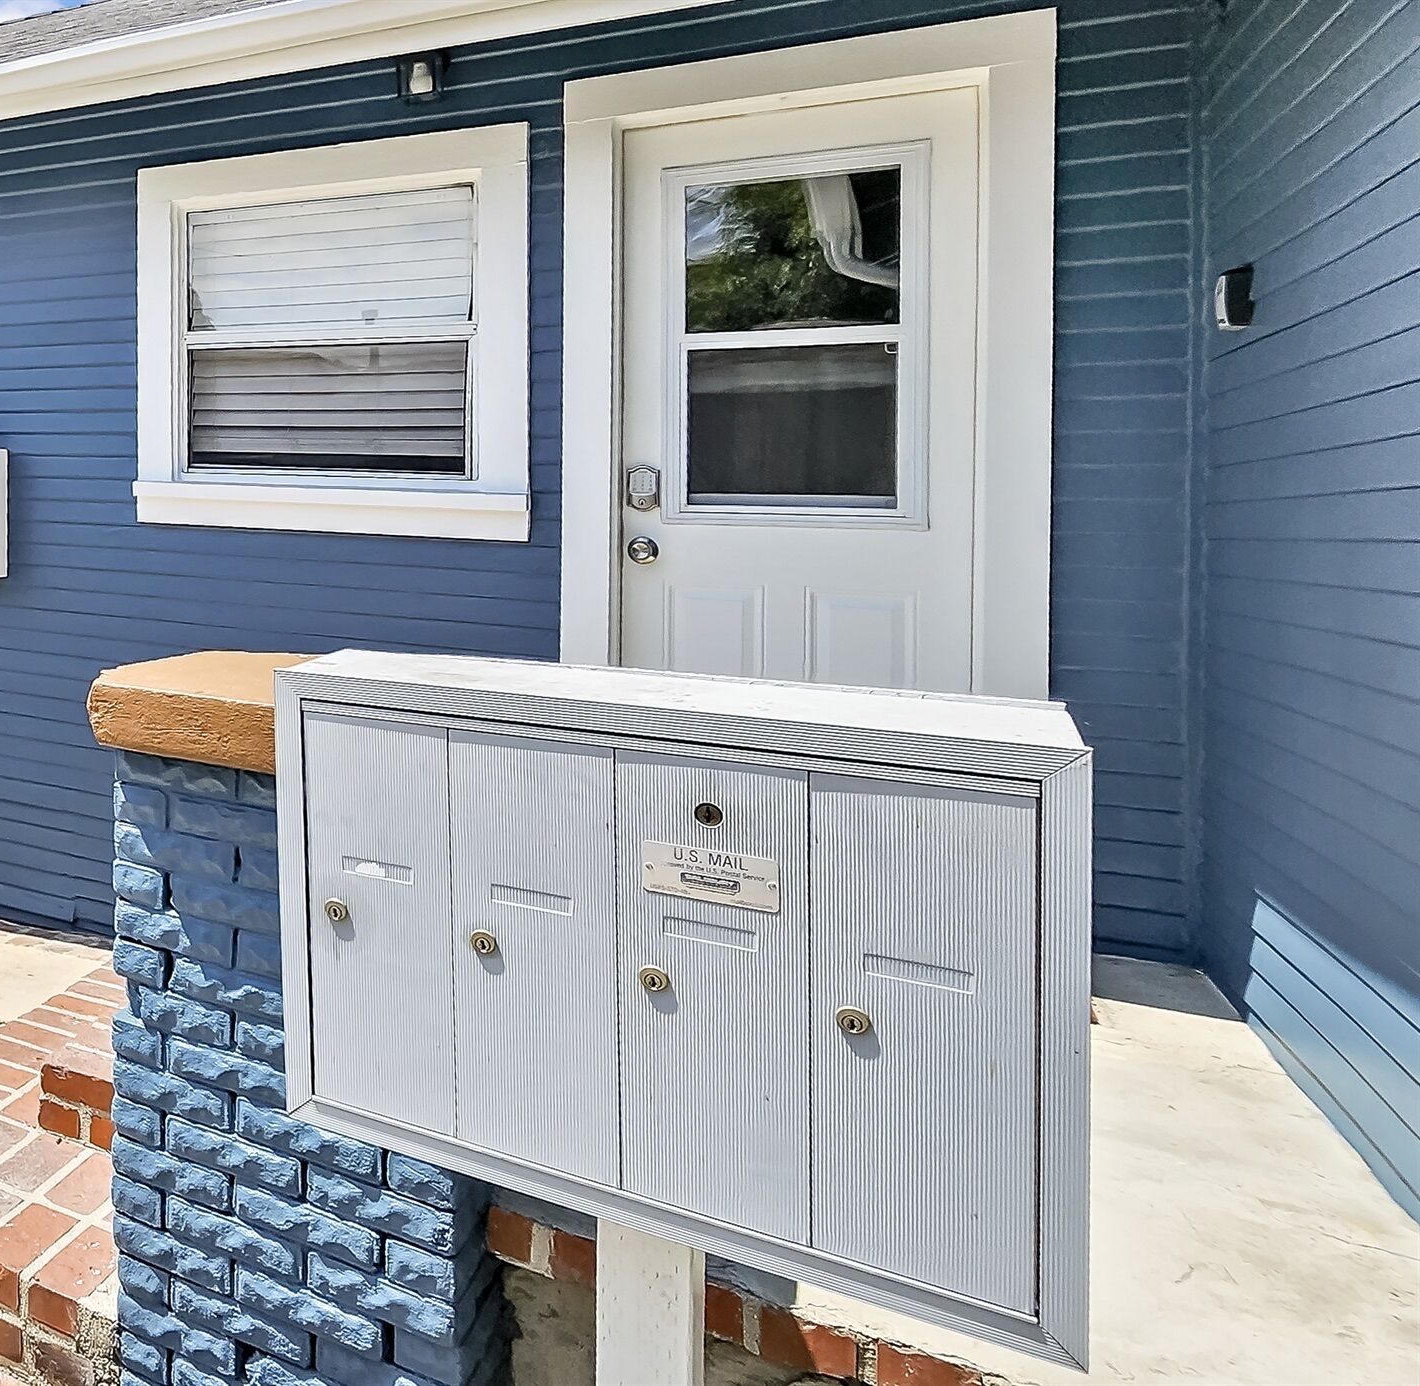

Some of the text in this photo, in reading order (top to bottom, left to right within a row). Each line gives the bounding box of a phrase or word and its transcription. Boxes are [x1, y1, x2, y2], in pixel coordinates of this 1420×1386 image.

[673, 848, 749, 871] U.S. MAIL
[720, 869, 741, 878] Postal
[742, 873, 765, 882] Service
